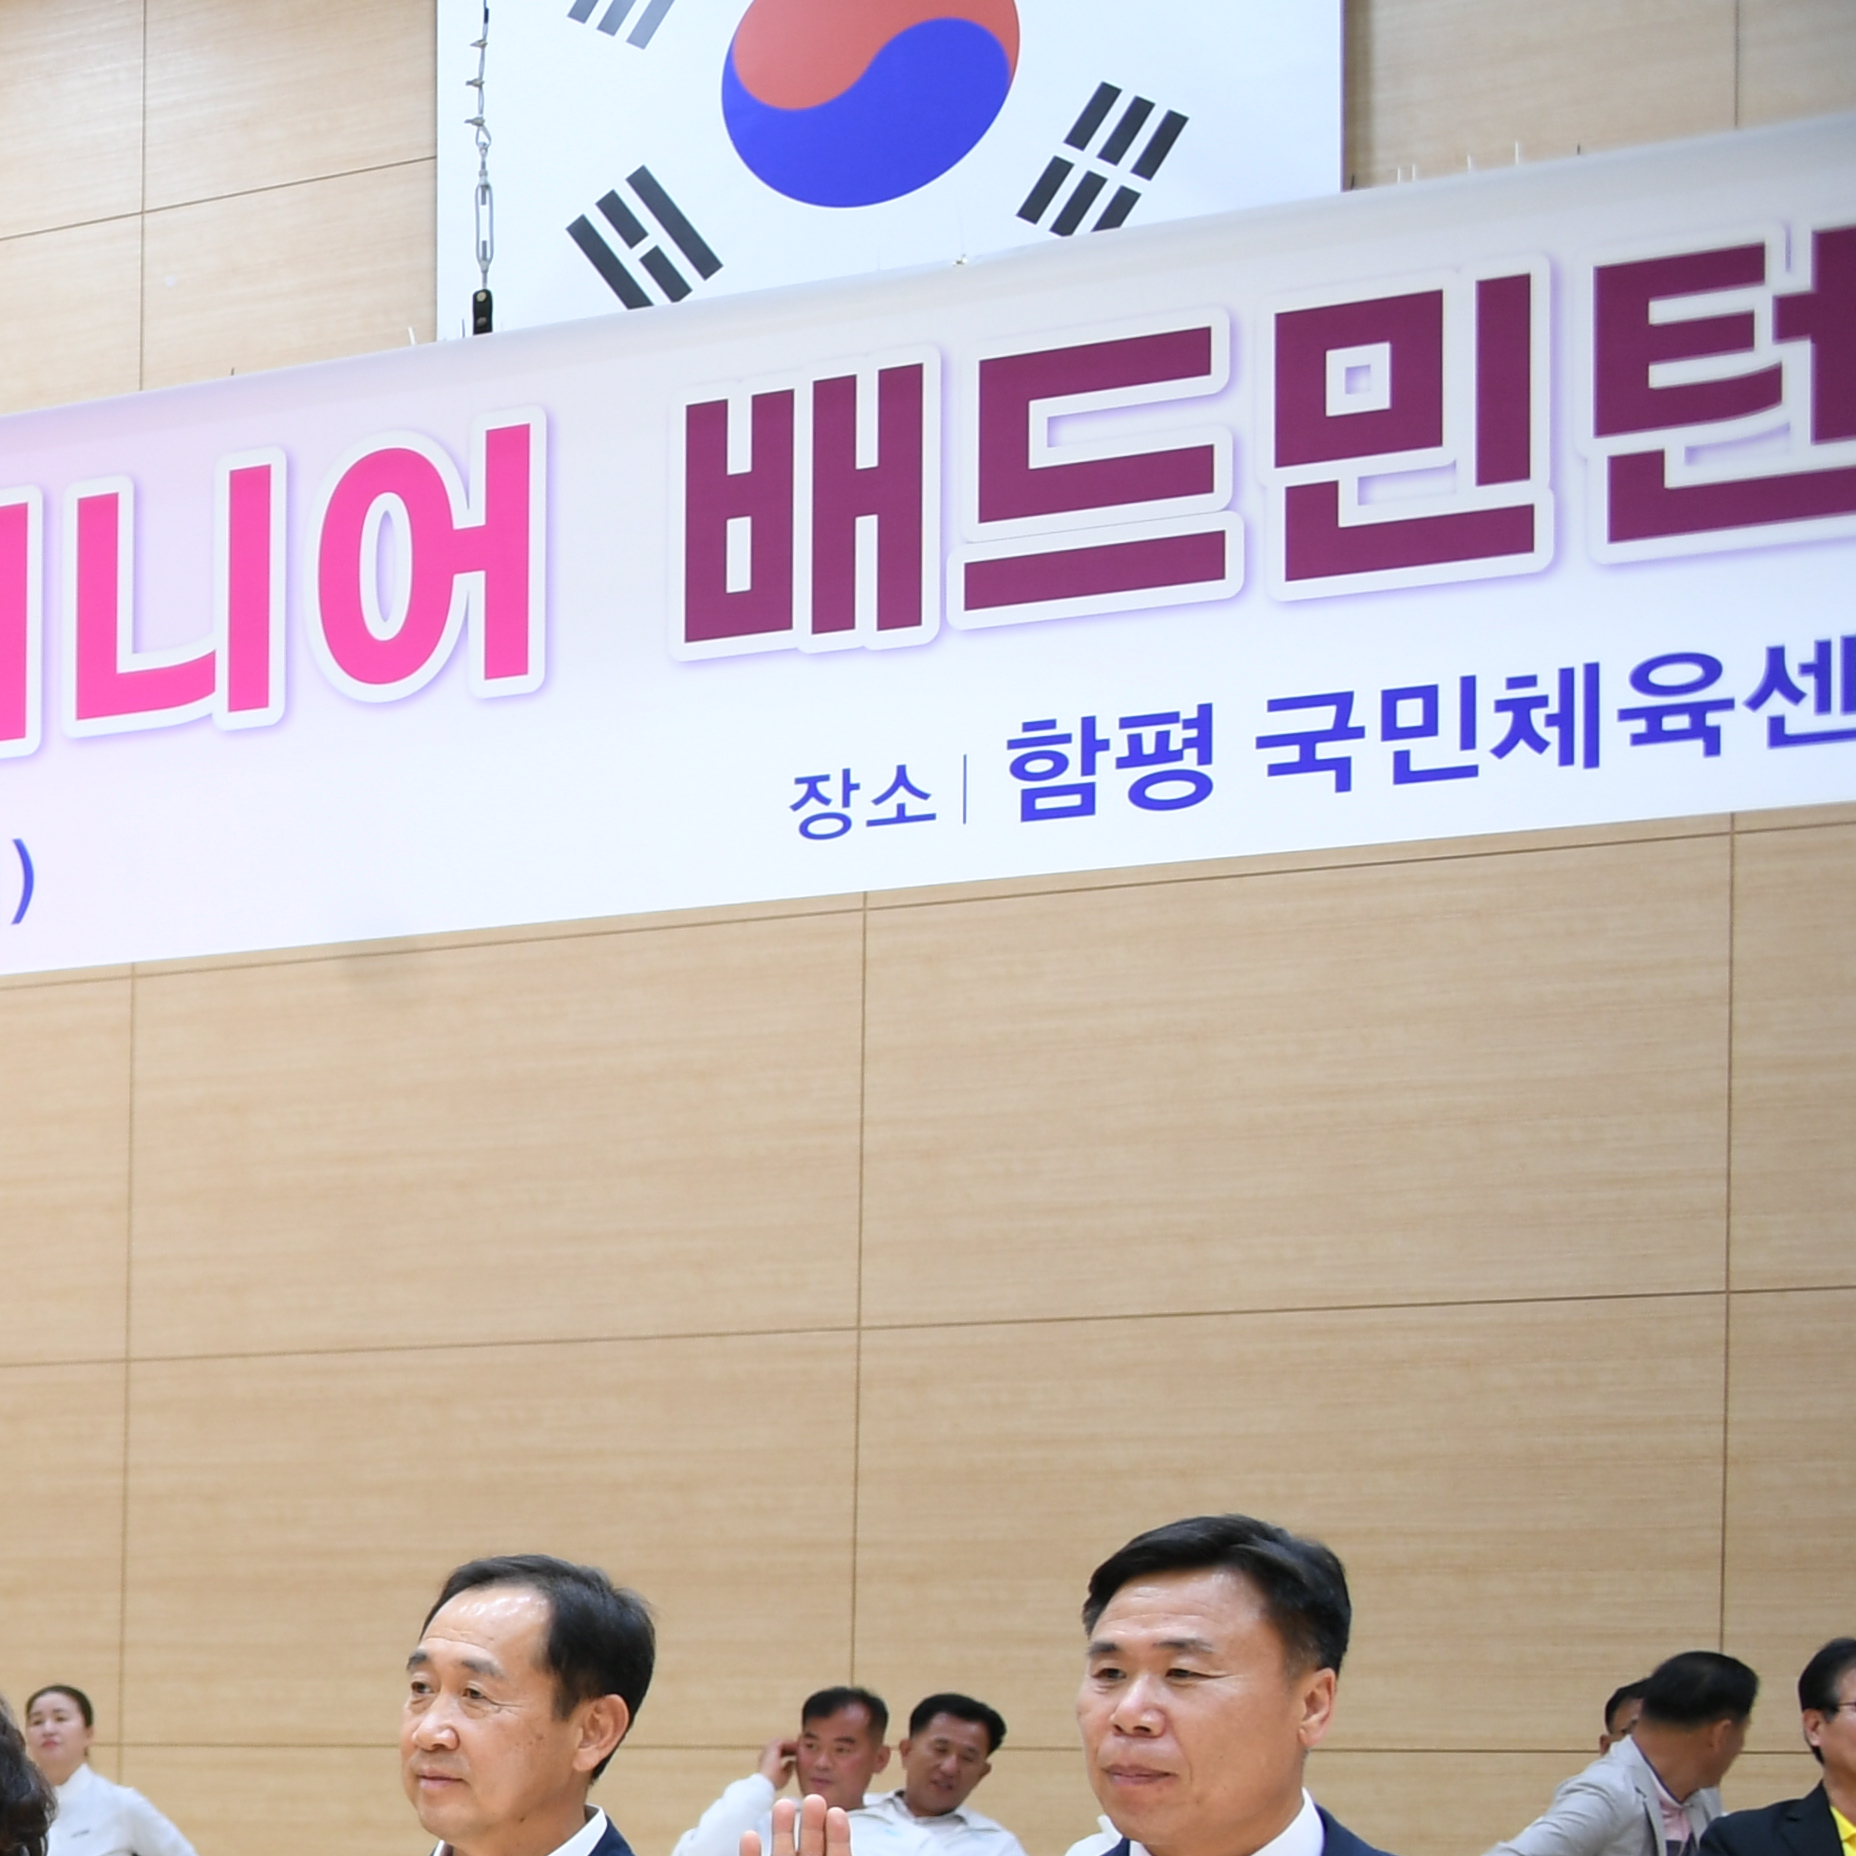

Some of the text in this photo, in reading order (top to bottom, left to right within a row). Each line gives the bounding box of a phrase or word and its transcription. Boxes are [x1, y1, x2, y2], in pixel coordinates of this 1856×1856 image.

[683, 224, 1856, 643] 배드민턴
[788, 634, 1856, 841] 장소 함평 국민체육센
